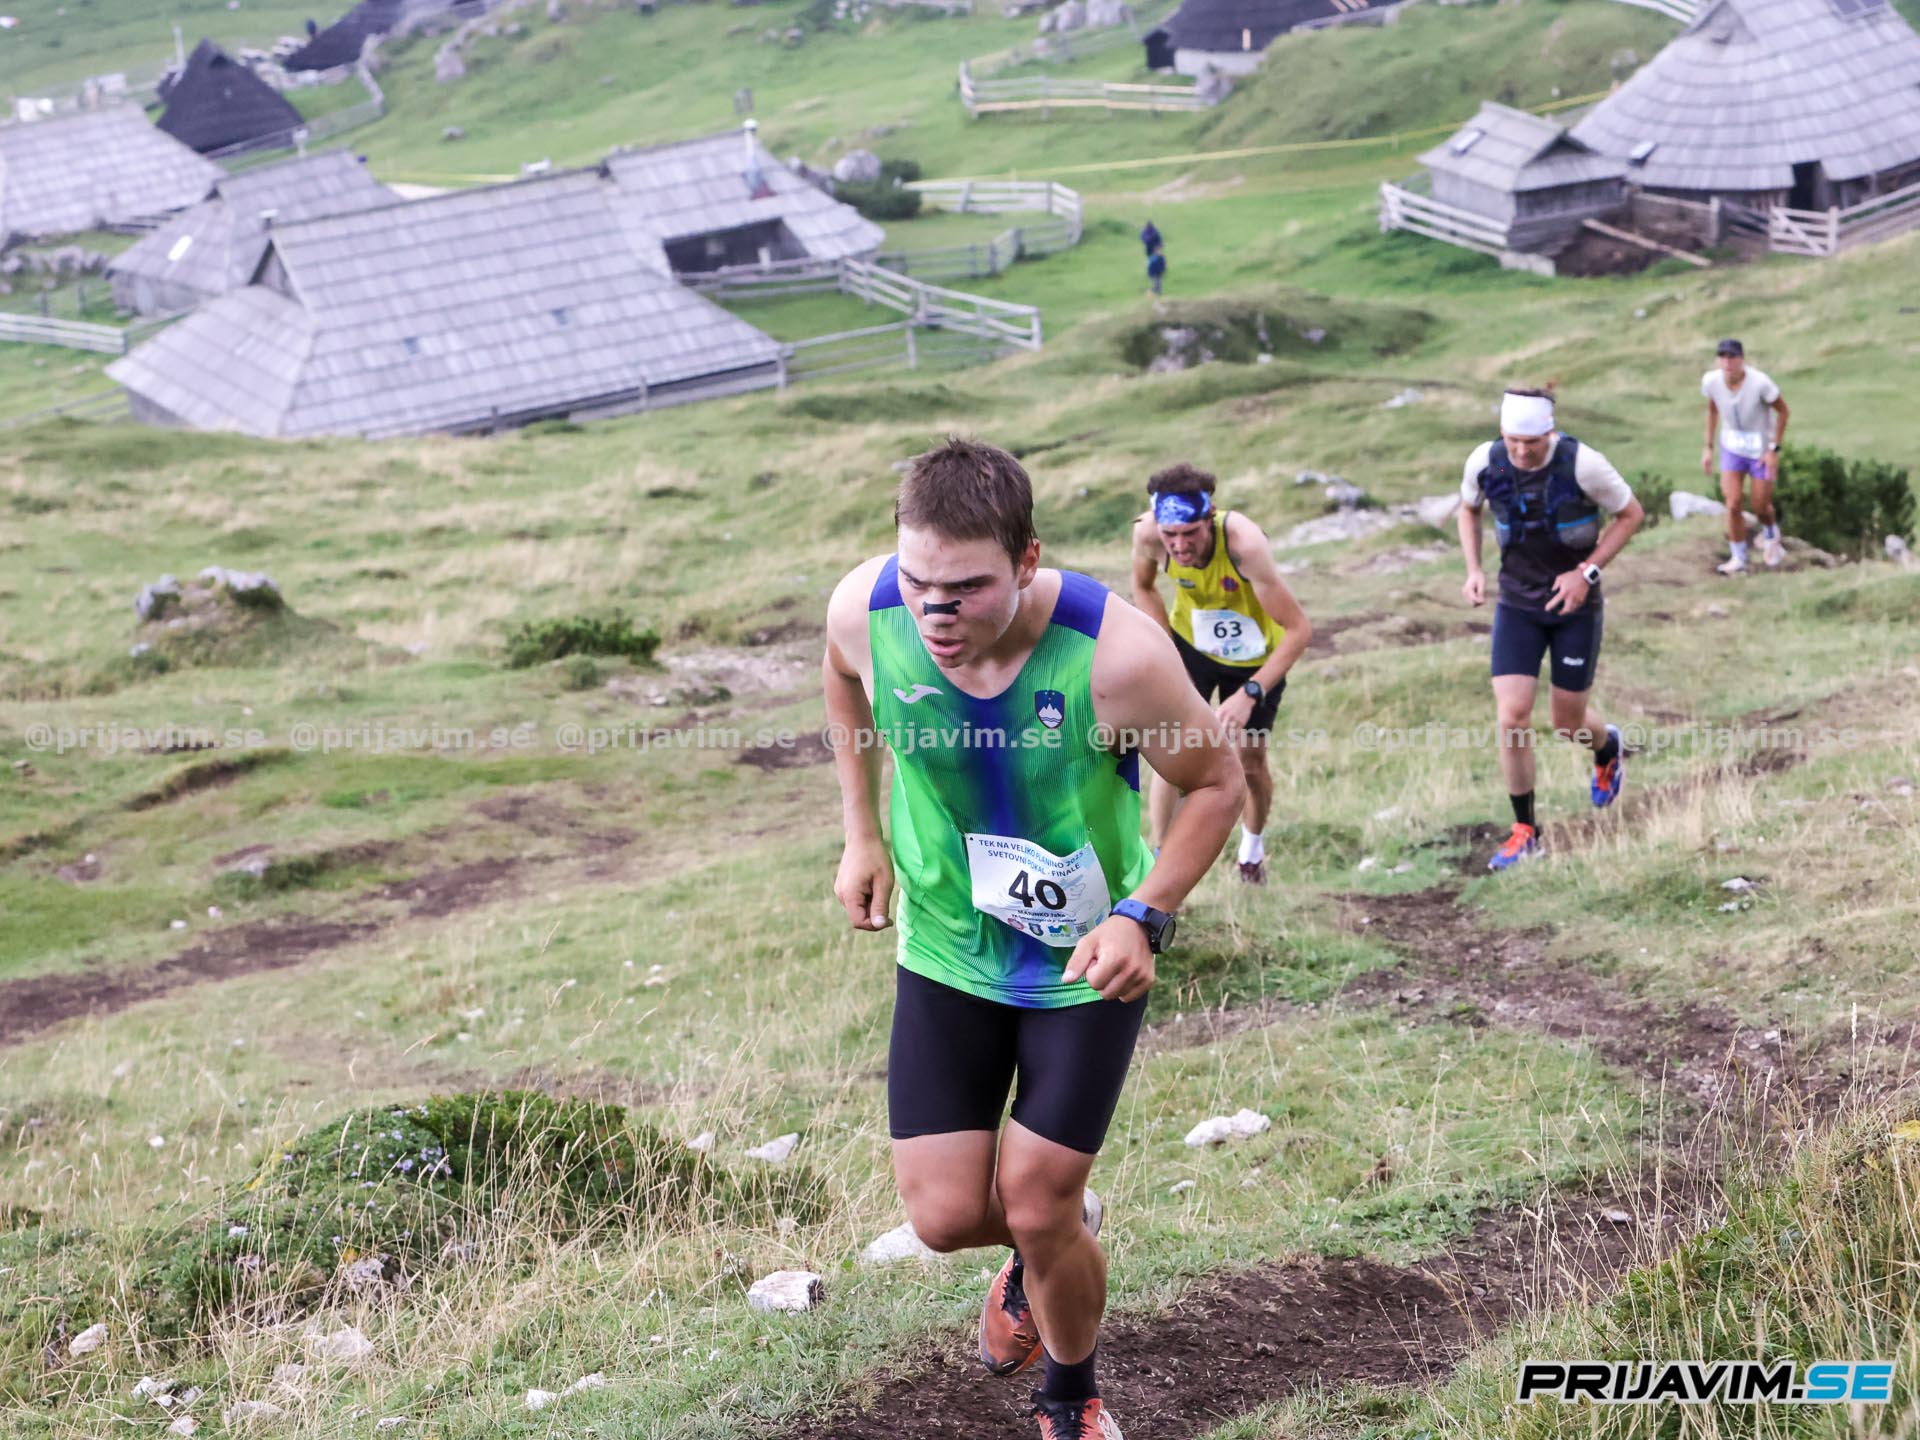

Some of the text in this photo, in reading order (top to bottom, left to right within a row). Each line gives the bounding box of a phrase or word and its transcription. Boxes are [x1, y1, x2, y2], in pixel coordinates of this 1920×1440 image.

[1214, 621, 1242, 638] 63
[979, 840, 996, 848] TEK
[1011, 844, 1036, 857] VELIKO
[988, 850, 1027, 865] SVETOVNI
[1027, 859, 1046, 875] POKAL
[1051, 863, 1080, 877] FINALE
[1008, 870, 1067, 910] 40
